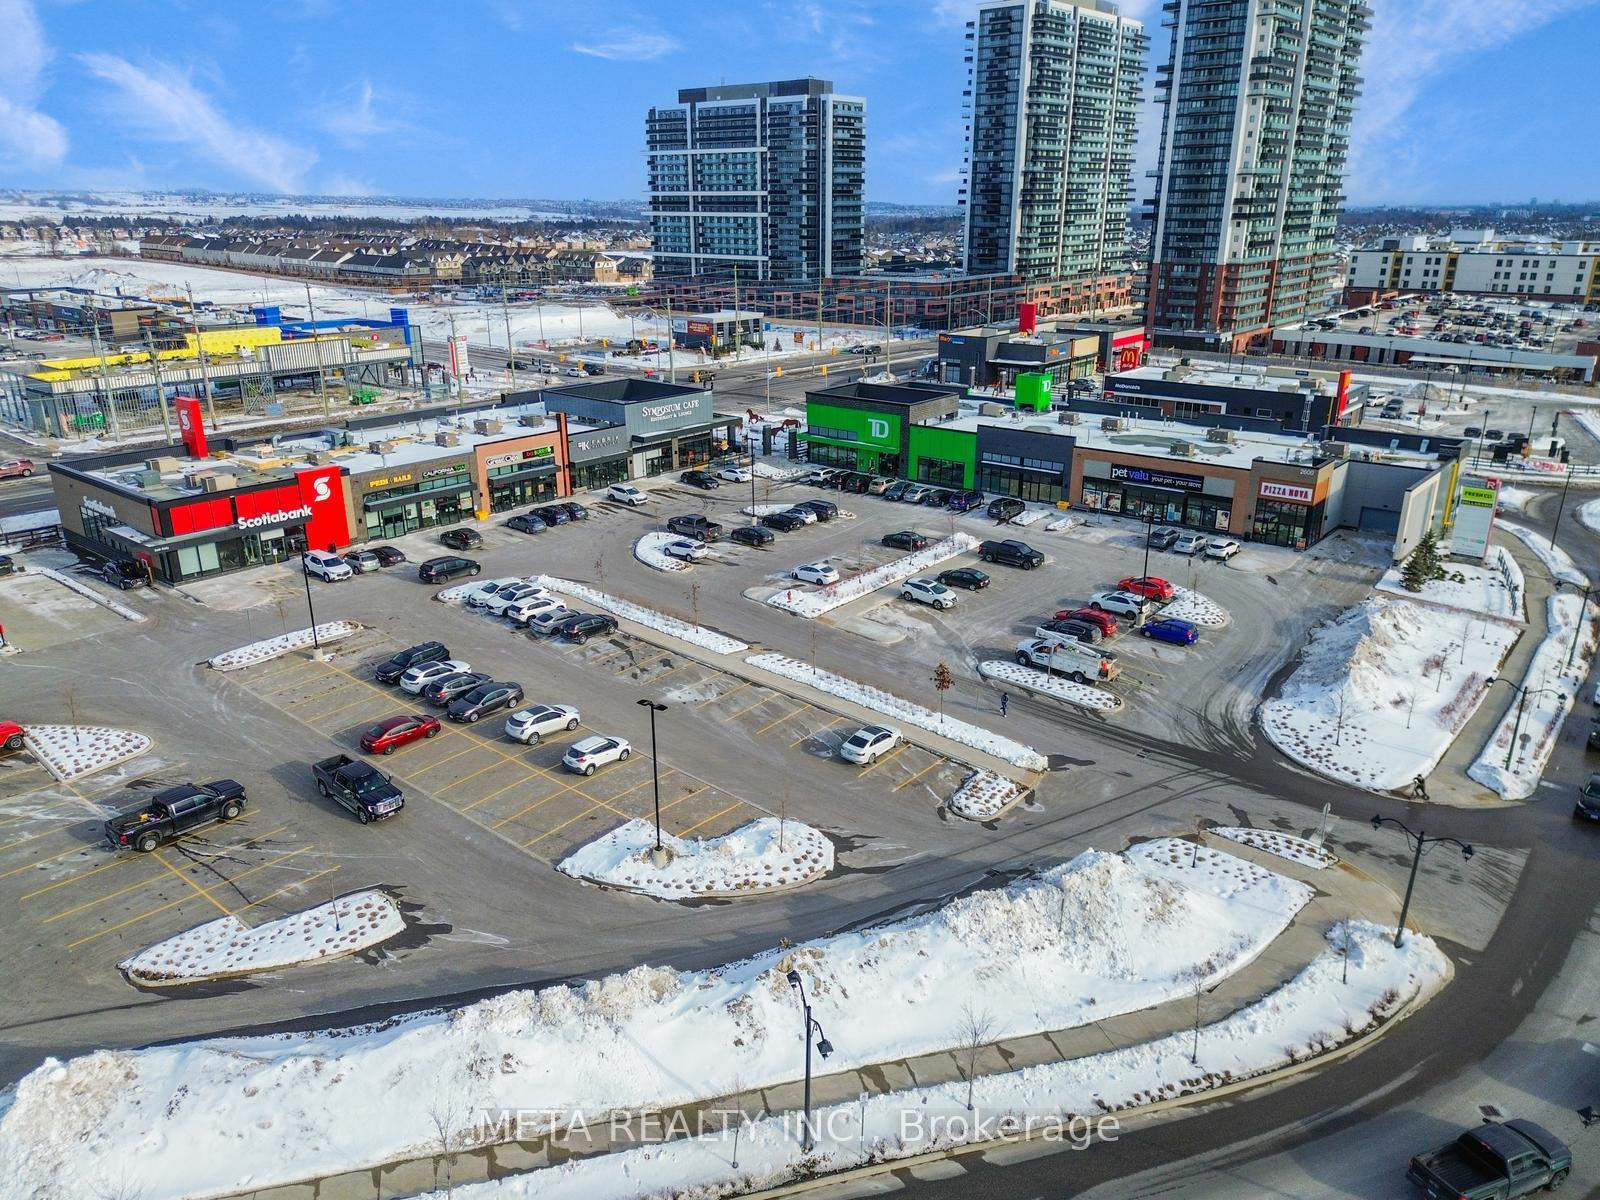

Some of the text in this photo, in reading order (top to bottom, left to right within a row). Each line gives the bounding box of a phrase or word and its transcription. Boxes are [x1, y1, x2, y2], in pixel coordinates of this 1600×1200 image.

[1042, 380, 1051, 392] TD
[683, 400, 699, 409] CAFE
[868, 418, 888, 438] TD
[1533, 462, 1565, 472] OPEN
[1112, 467, 1149, 480] pet valu
[1188, 481, 1201, 489] store
[1263, 485, 1309, 499] PIZZA NOVA
[237, 504, 312, 530] Scotiabank
